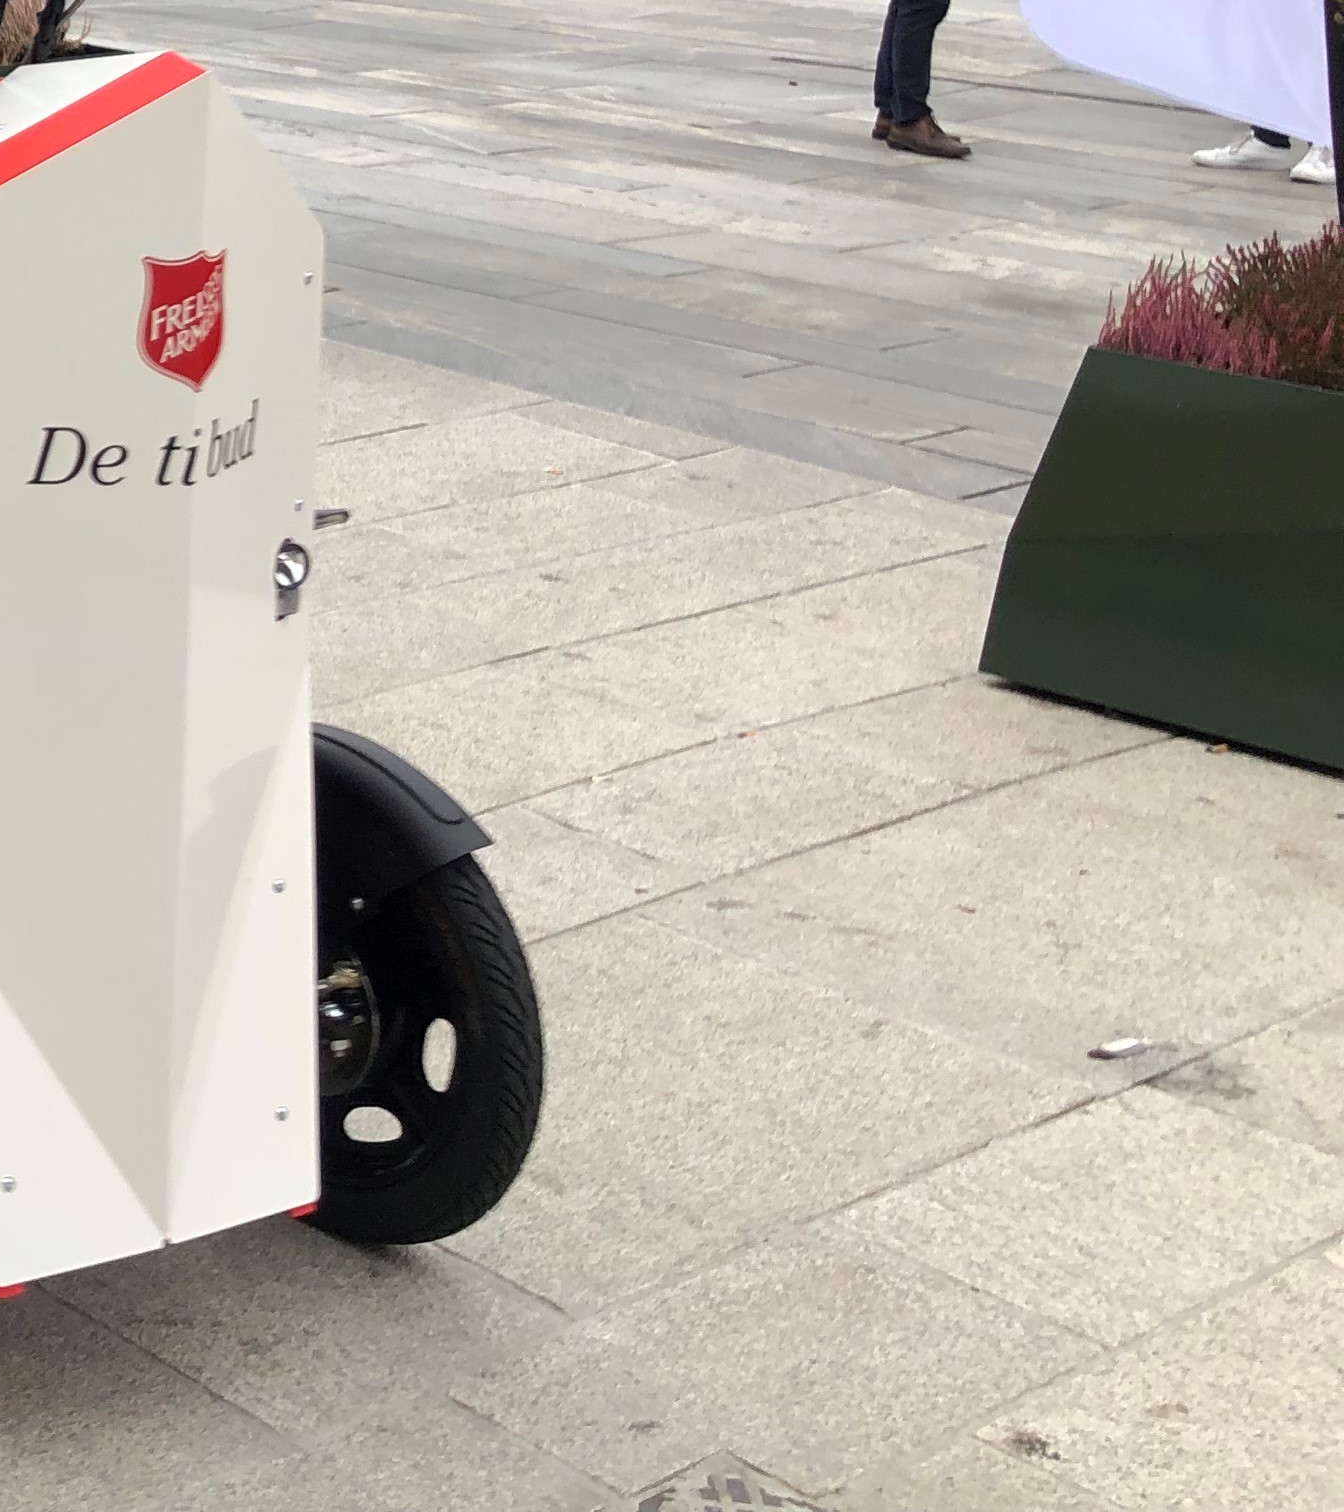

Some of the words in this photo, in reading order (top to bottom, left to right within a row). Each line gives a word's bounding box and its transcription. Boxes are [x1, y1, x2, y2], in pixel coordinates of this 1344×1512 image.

[26, 426, 129, 487] De
[154, 427, 203, 487] ti
[206, 398, 260, 477] bud
